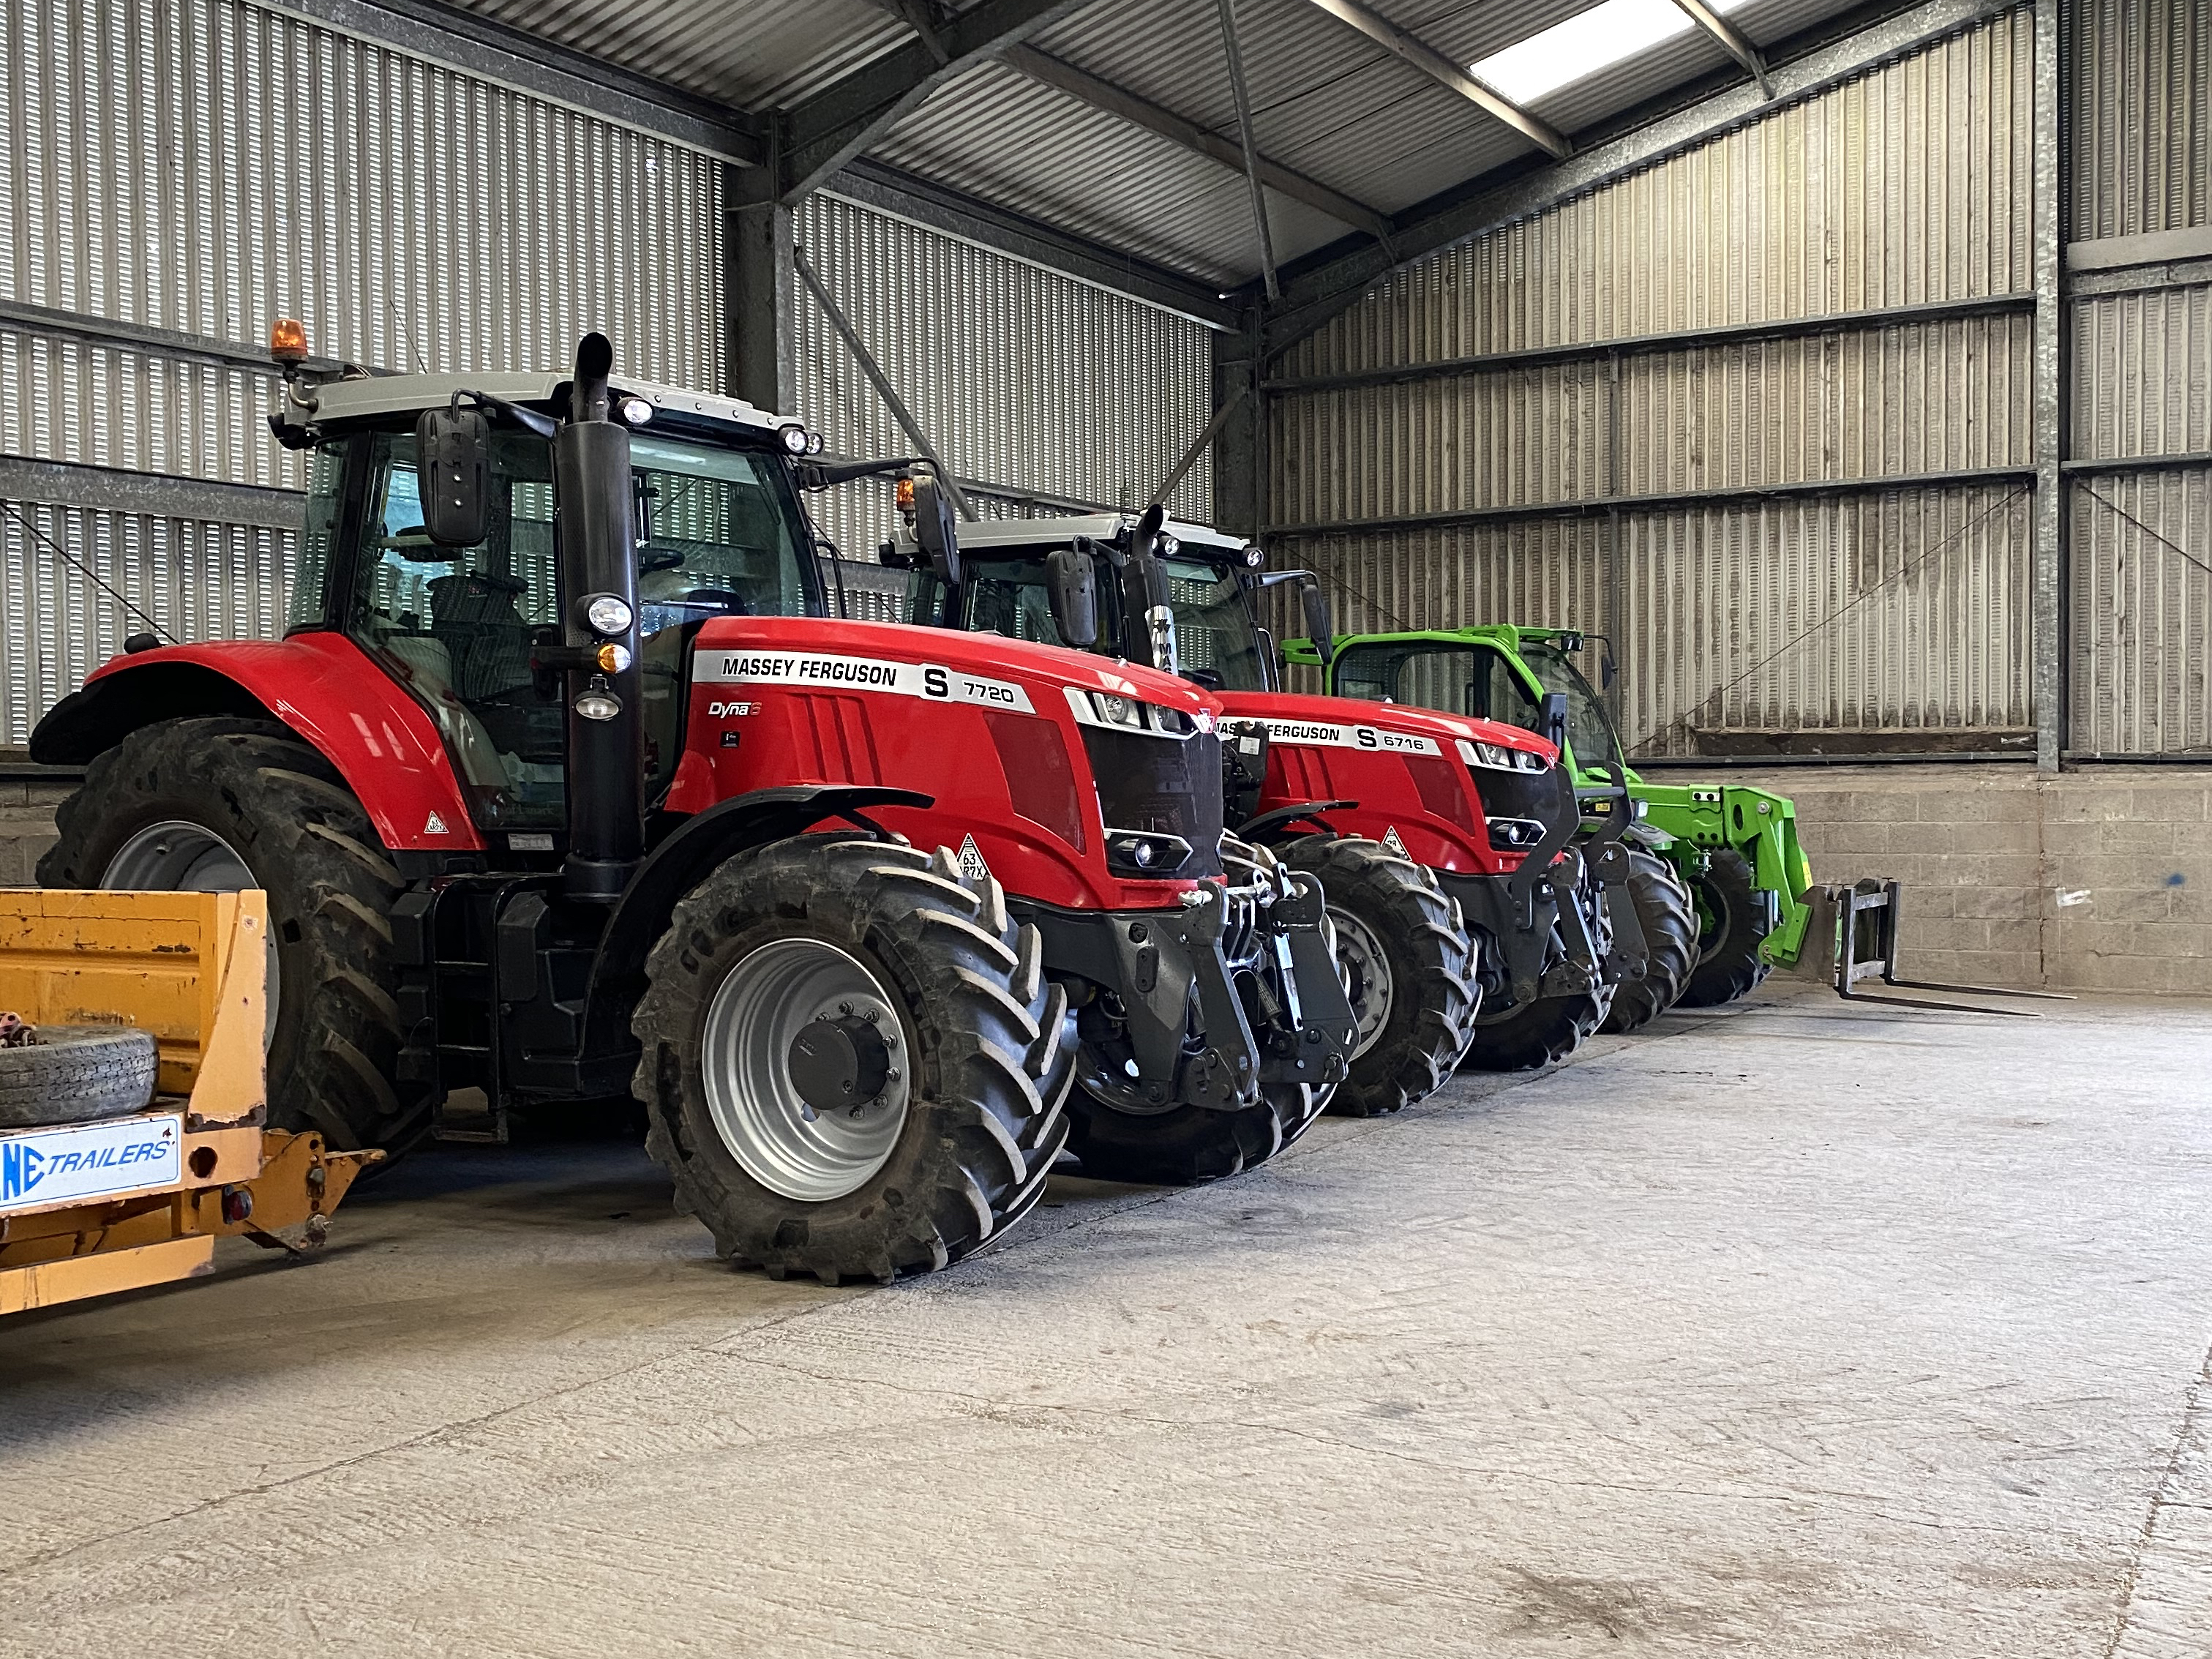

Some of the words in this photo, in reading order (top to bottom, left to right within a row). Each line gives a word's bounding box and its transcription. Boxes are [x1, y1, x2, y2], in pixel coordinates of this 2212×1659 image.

[722, 658, 795, 677] MASSEY
[799, 660, 897, 686] FERGUSON
[924, 668, 949, 697] S
[963, 681, 1015, 703] 7720
[1267, 724, 1340, 741] FERGUSON
[1357, 728, 1377, 748] S
[1384, 736, 1425, 750] 6716
[964, 853, 975, 865] 63
[0, 1143, 45, 1201] NE
[48, 1140, 170, 1175] TRAILERS
